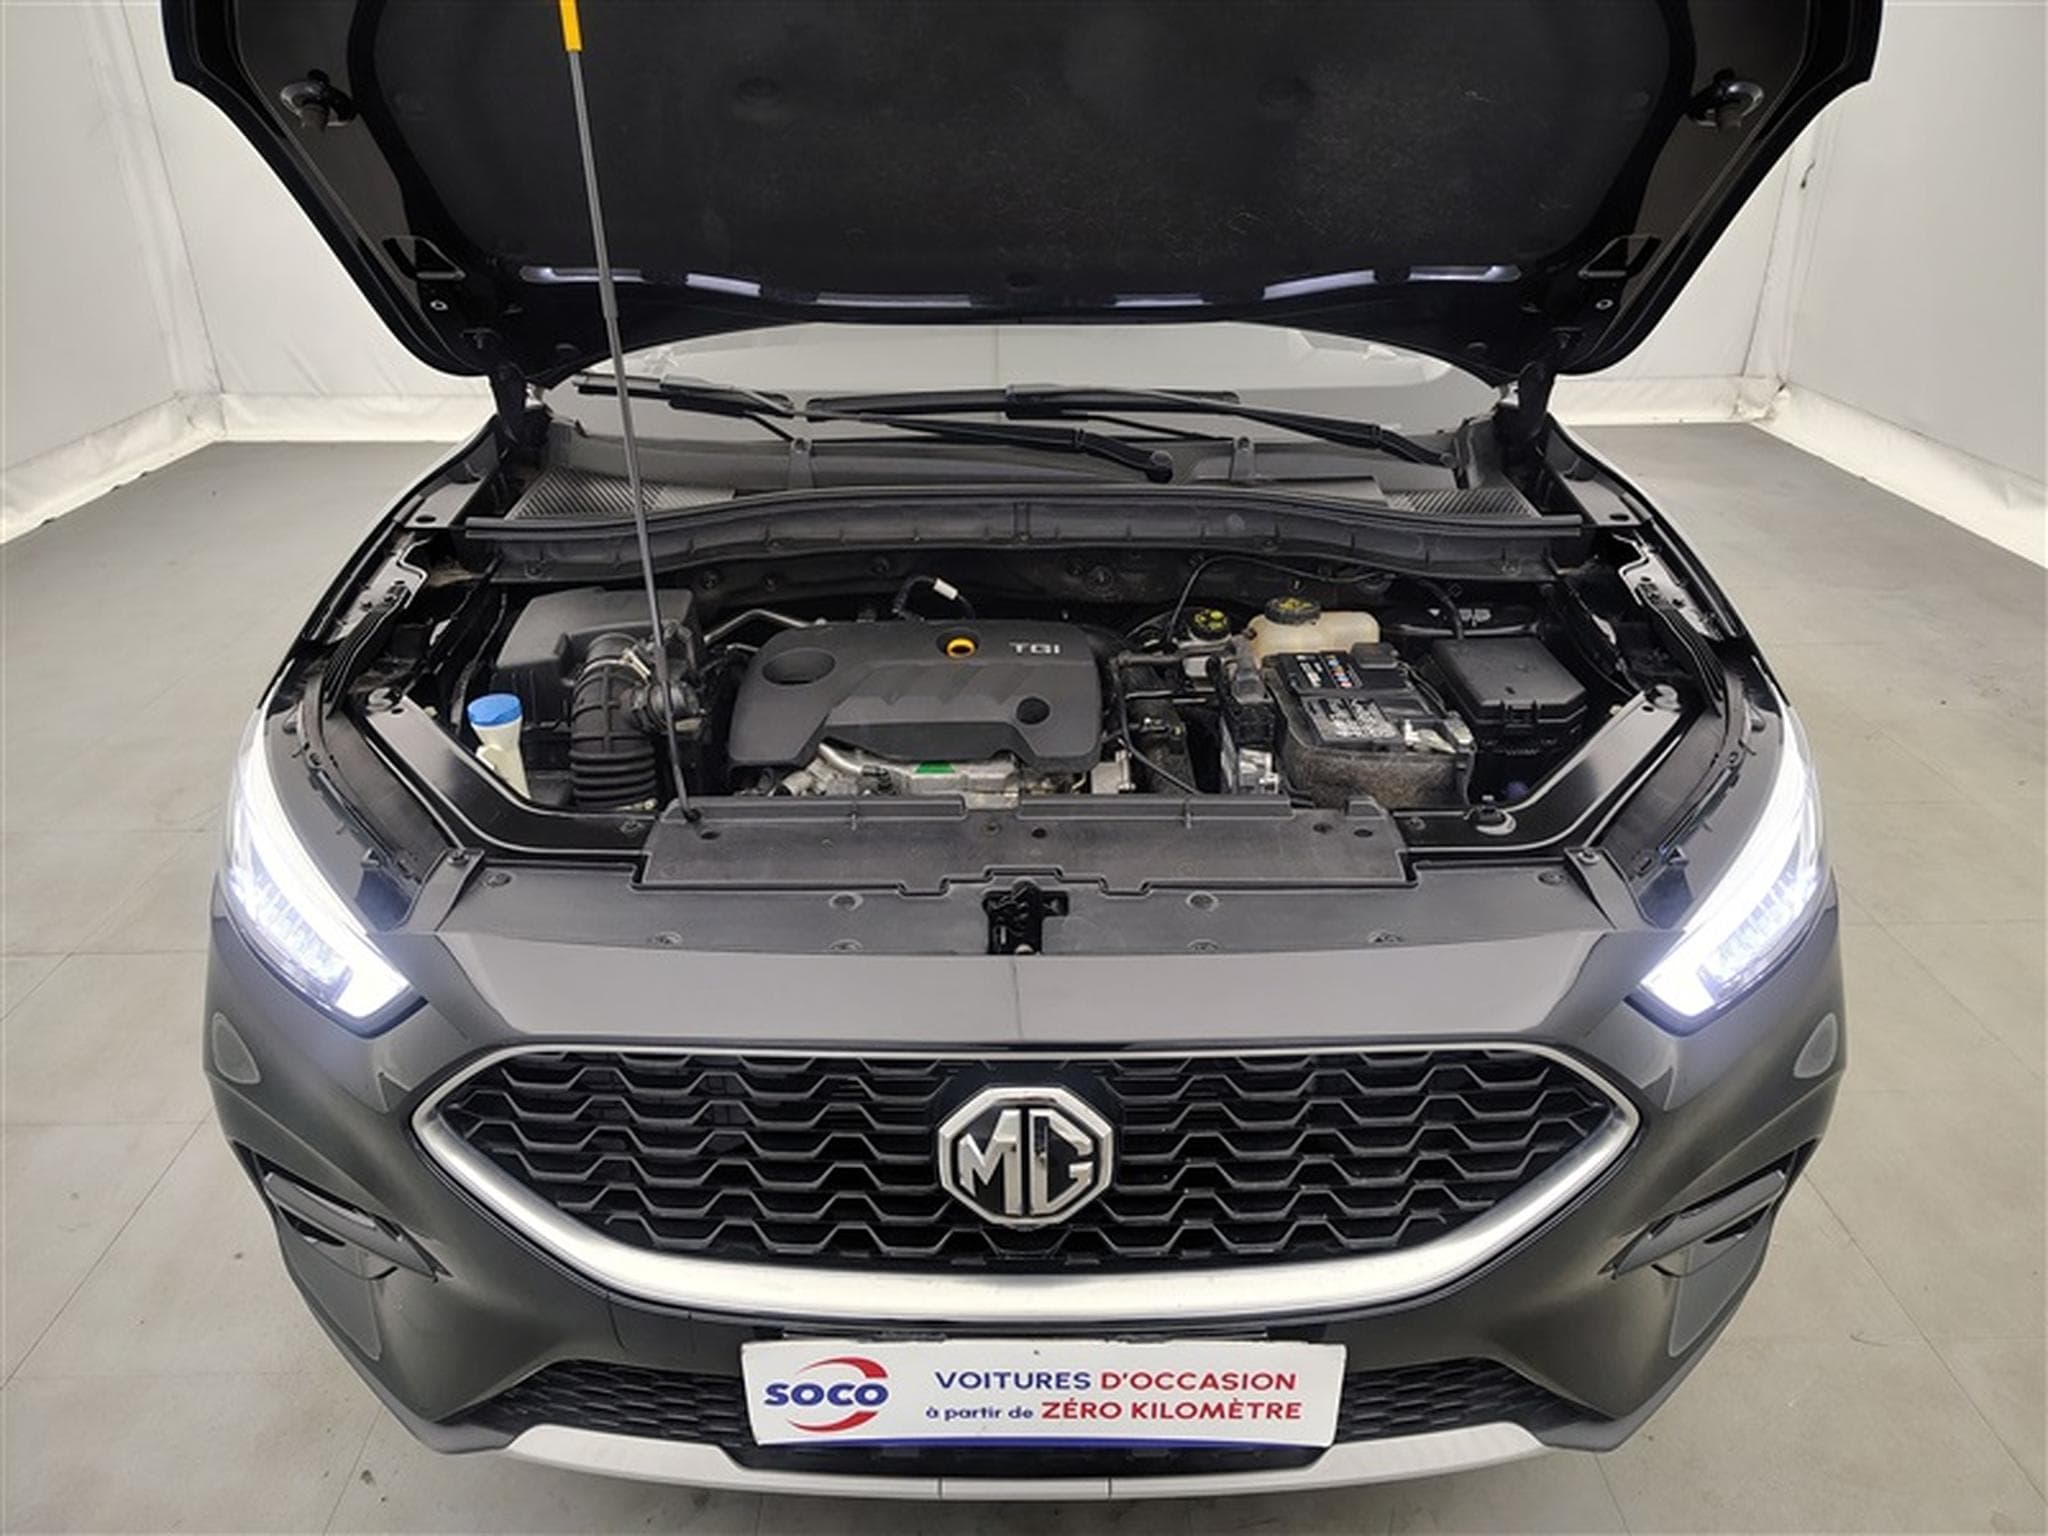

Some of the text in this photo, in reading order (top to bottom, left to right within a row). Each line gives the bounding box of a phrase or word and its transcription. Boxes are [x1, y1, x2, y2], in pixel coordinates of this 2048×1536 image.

[1008, 642, 1061, 655] TGI
[958, 1108, 1095, 1216] MG
[935, 1371, 1297, 1391] VOITURES D'OCCASION
[764, 1382, 889, 1407] SOCO
[926, 1397, 1303, 1422] à partir de ZÉRO KILOMÈTRE
